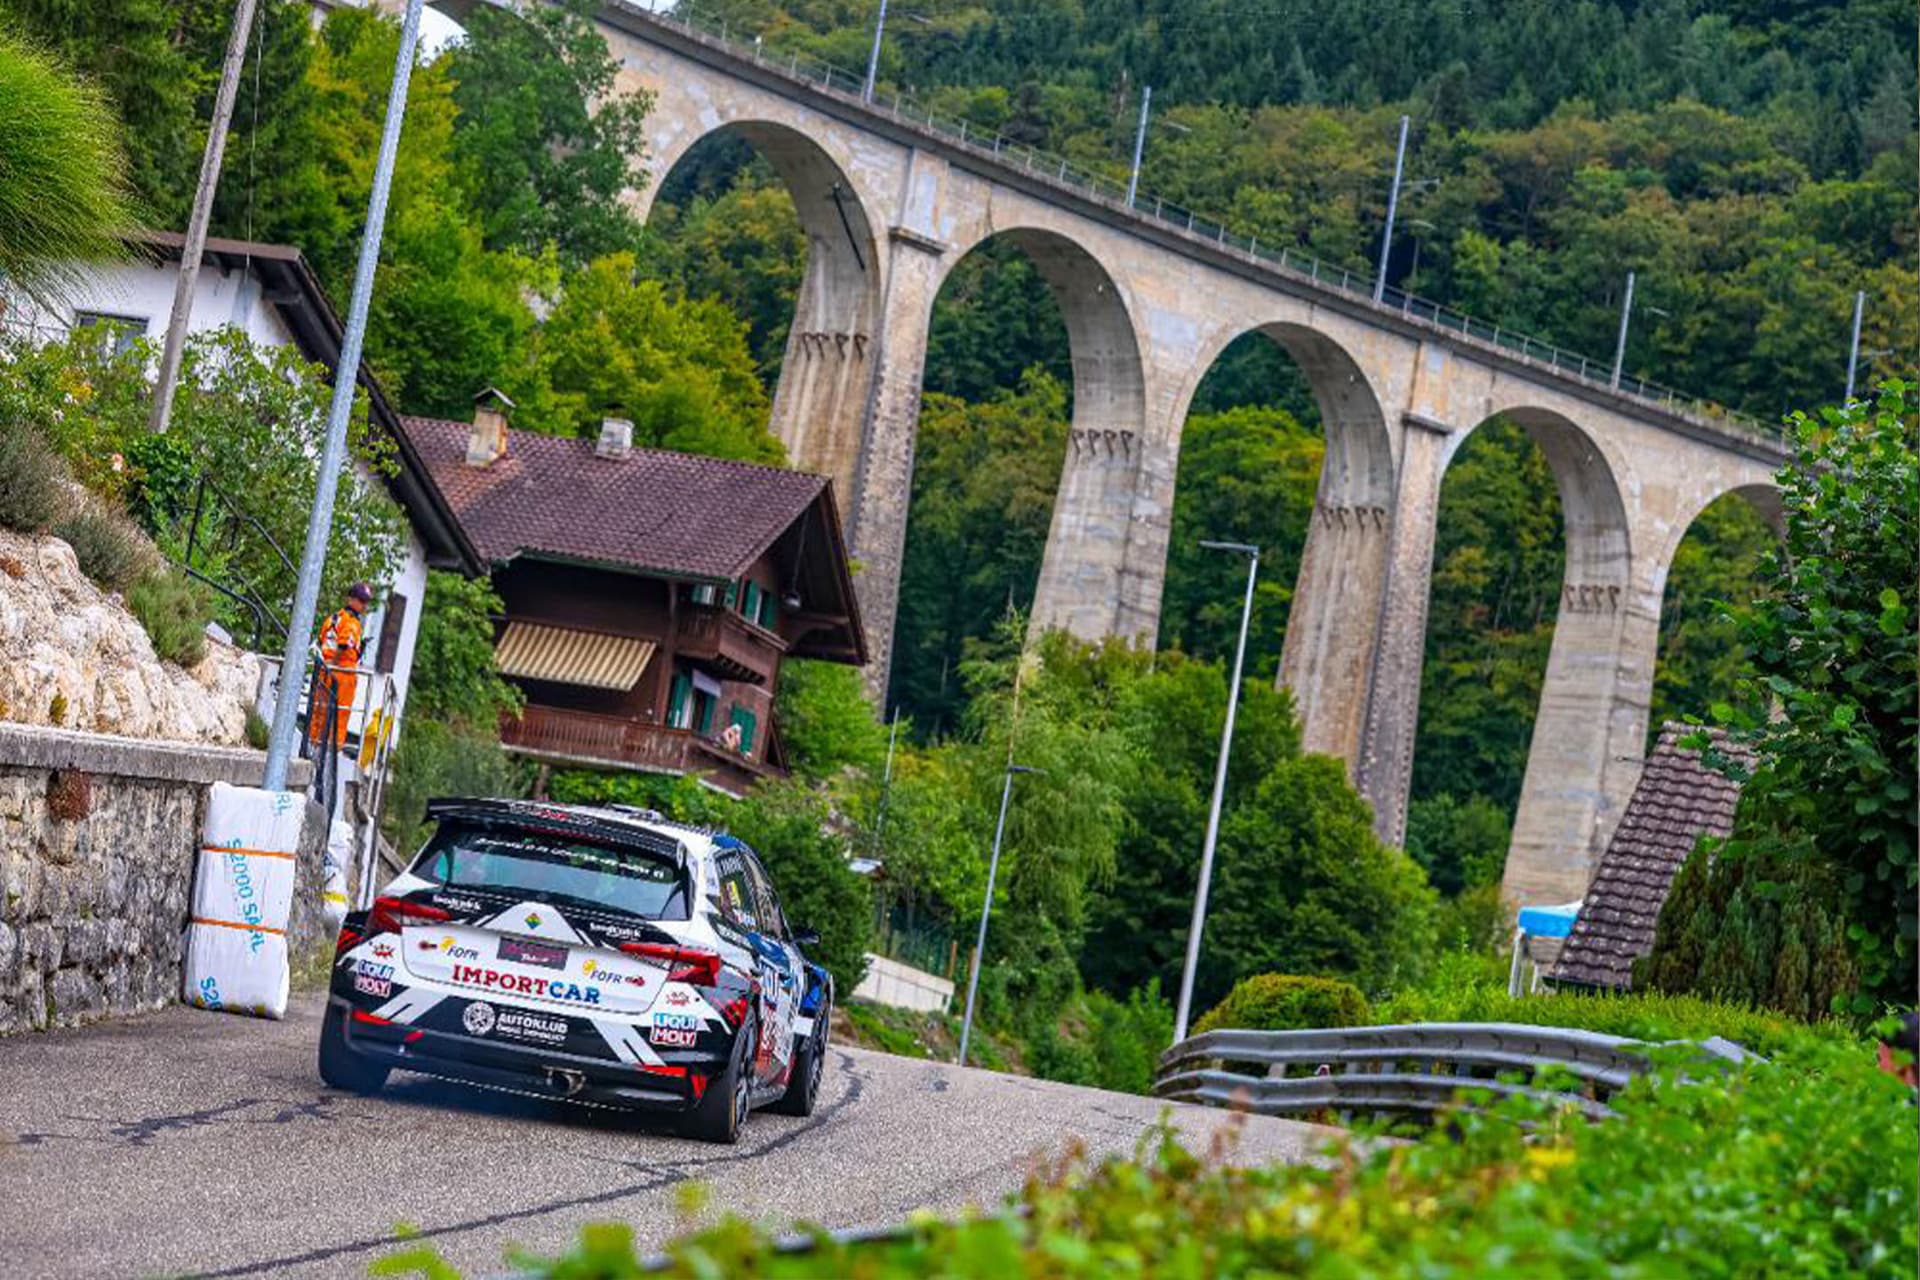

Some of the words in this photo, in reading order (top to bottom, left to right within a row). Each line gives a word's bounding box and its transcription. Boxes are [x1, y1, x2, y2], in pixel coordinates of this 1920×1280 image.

[355, 976, 391, 997] MOLY
[498, 1013, 568, 1034] AUTOKLUB
[653, 1012, 697, 1032] LIQUI
[651, 1028, 697, 1048] MOLY
